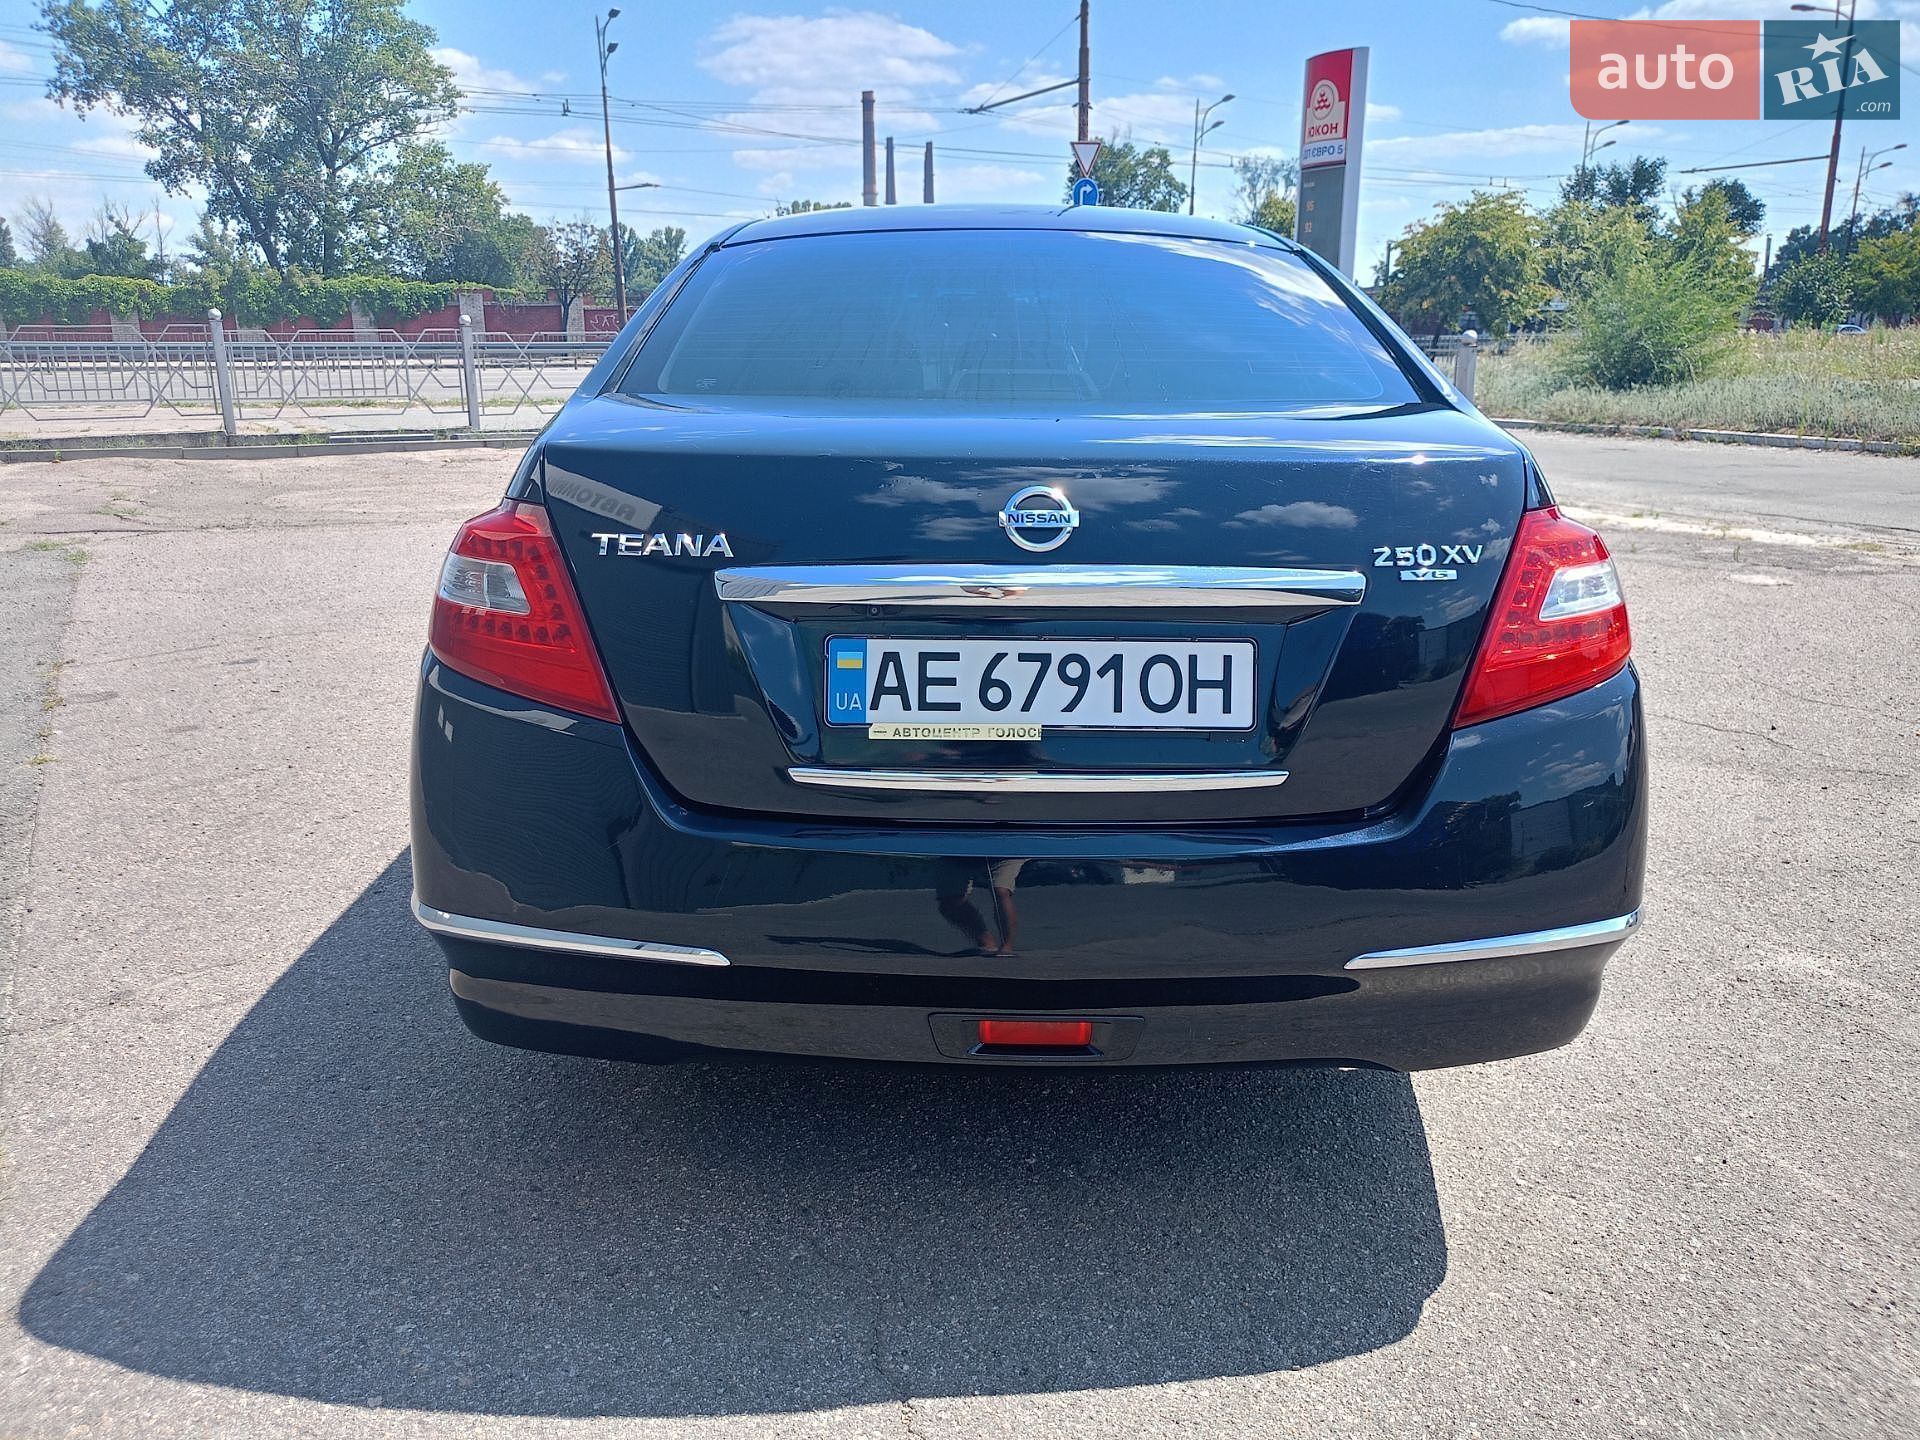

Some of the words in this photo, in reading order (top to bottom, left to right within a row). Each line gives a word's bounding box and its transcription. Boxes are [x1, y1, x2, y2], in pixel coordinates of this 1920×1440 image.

[1307, 122, 1338, 137] ЮКОН
[1007, 513, 1071, 524] NISSAN
[592, 533, 734, 557] TEANA
[1373, 544, 1437, 567] 250
[1442, 544, 1483, 565] XV
[869, 651, 961, 711] AE
[978, 652, 1123, 713] 6791
[1139, 654, 1232, 714] OH
[836, 692, 862, 711] UA
[892, 727, 981, 738] АВТОЦЕНТР
